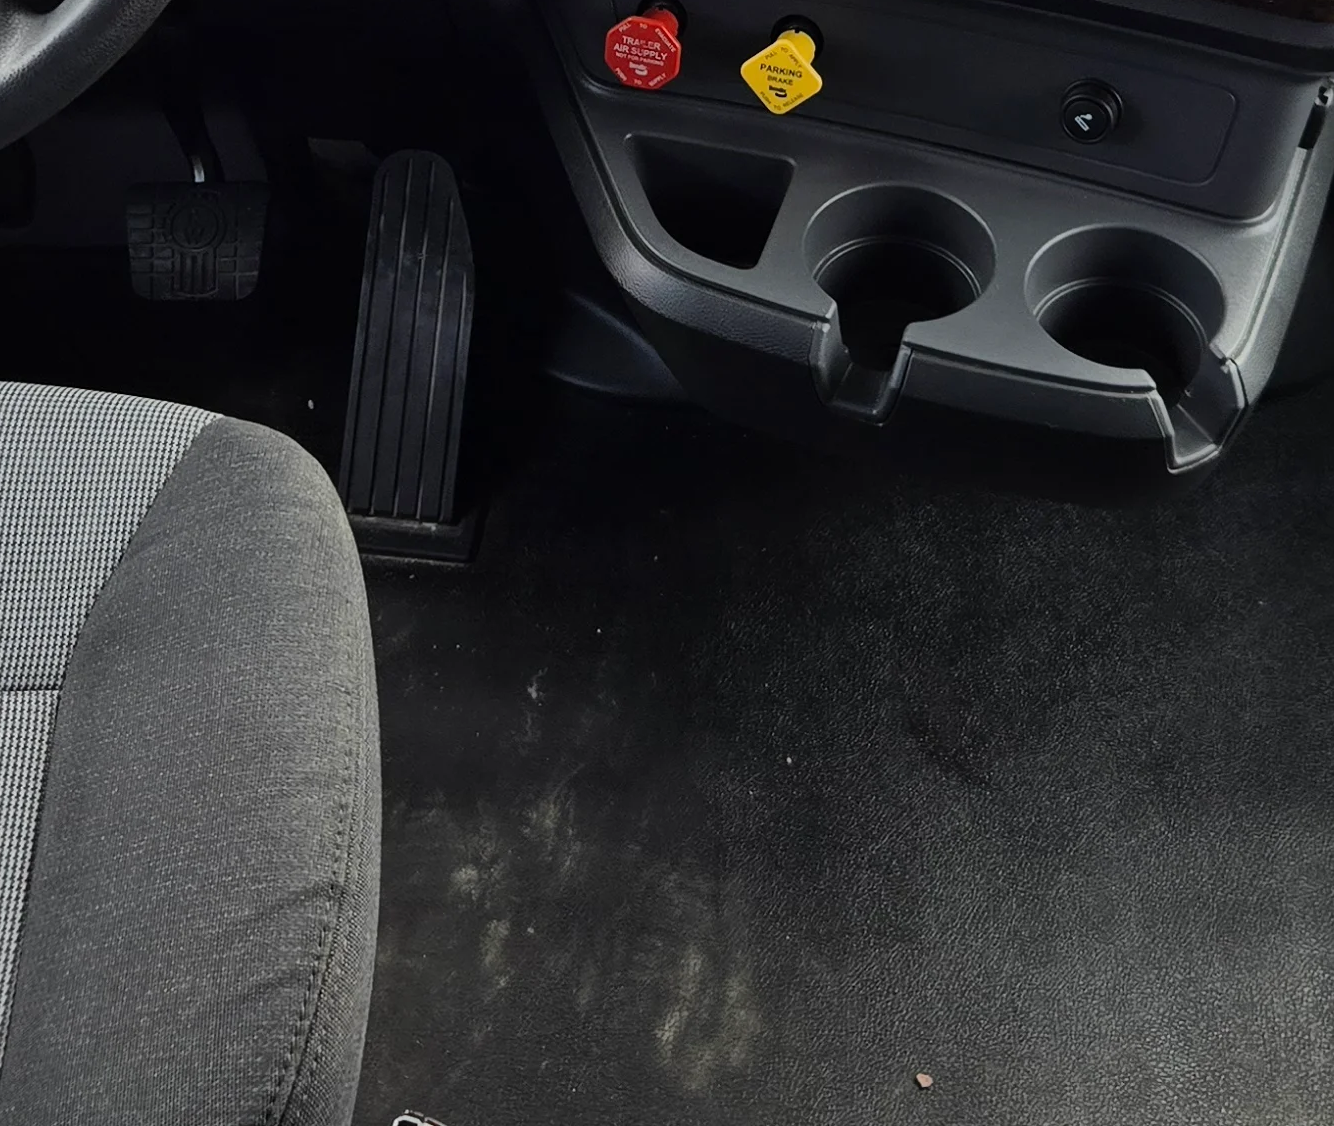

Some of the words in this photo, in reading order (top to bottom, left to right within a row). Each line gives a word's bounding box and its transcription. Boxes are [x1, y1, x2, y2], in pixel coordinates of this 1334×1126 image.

[613, 43, 630, 54] AIR
[630, 46, 668, 61] SUPPLY
[759, 63, 803, 79] PARKING
[767, 75, 794, 86] BRAKE
